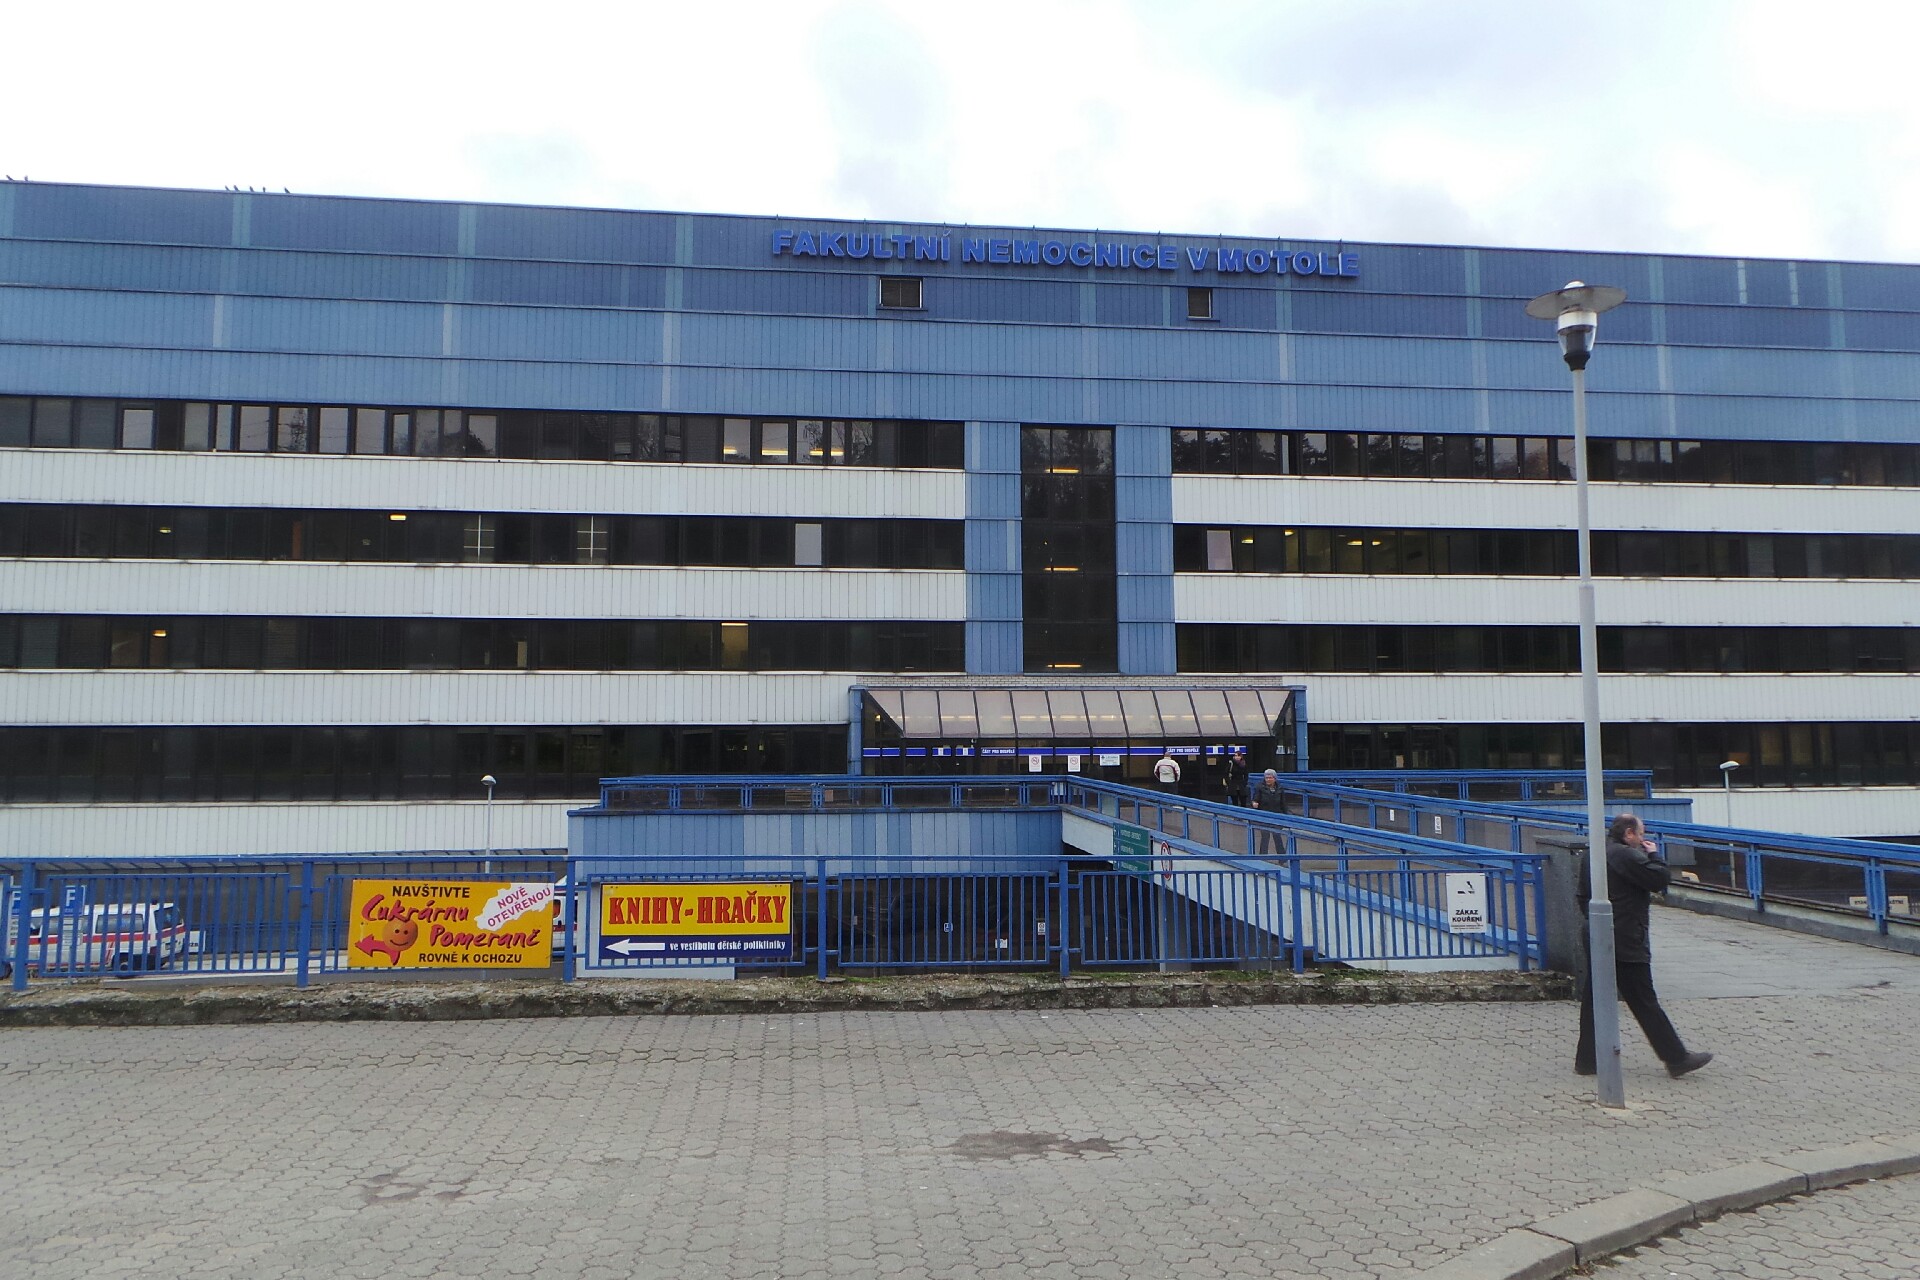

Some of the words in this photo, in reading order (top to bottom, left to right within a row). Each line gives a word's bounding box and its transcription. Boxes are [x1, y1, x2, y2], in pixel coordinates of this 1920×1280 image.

[772, 229, 951, 261] FAKULTNÍ
[962, 238, 1179, 270] NEMOCNICE
[1186, 247, 1209, 271] V
[1217, 247, 1360, 277] MOTOLE
[392, 884, 470, 899] NAVŠTIVTE
[497, 886, 528, 909] NOVĚ
[361, 894, 470, 923] Cukrárnu
[487, 887, 551, 928] OTEVŘENOU
[430, 924, 541, 949] Pomeranč
[669, 943, 679, 951] ve
[680, 941, 715, 951] vestibulu
[717, 941, 742, 951] dětské
[744, 940, 786, 953] polikliniky
[418, 951, 458, 963] ROVNĚ
[462, 953, 469, 963] K
[473, 953, 522, 964] OCHOZU
